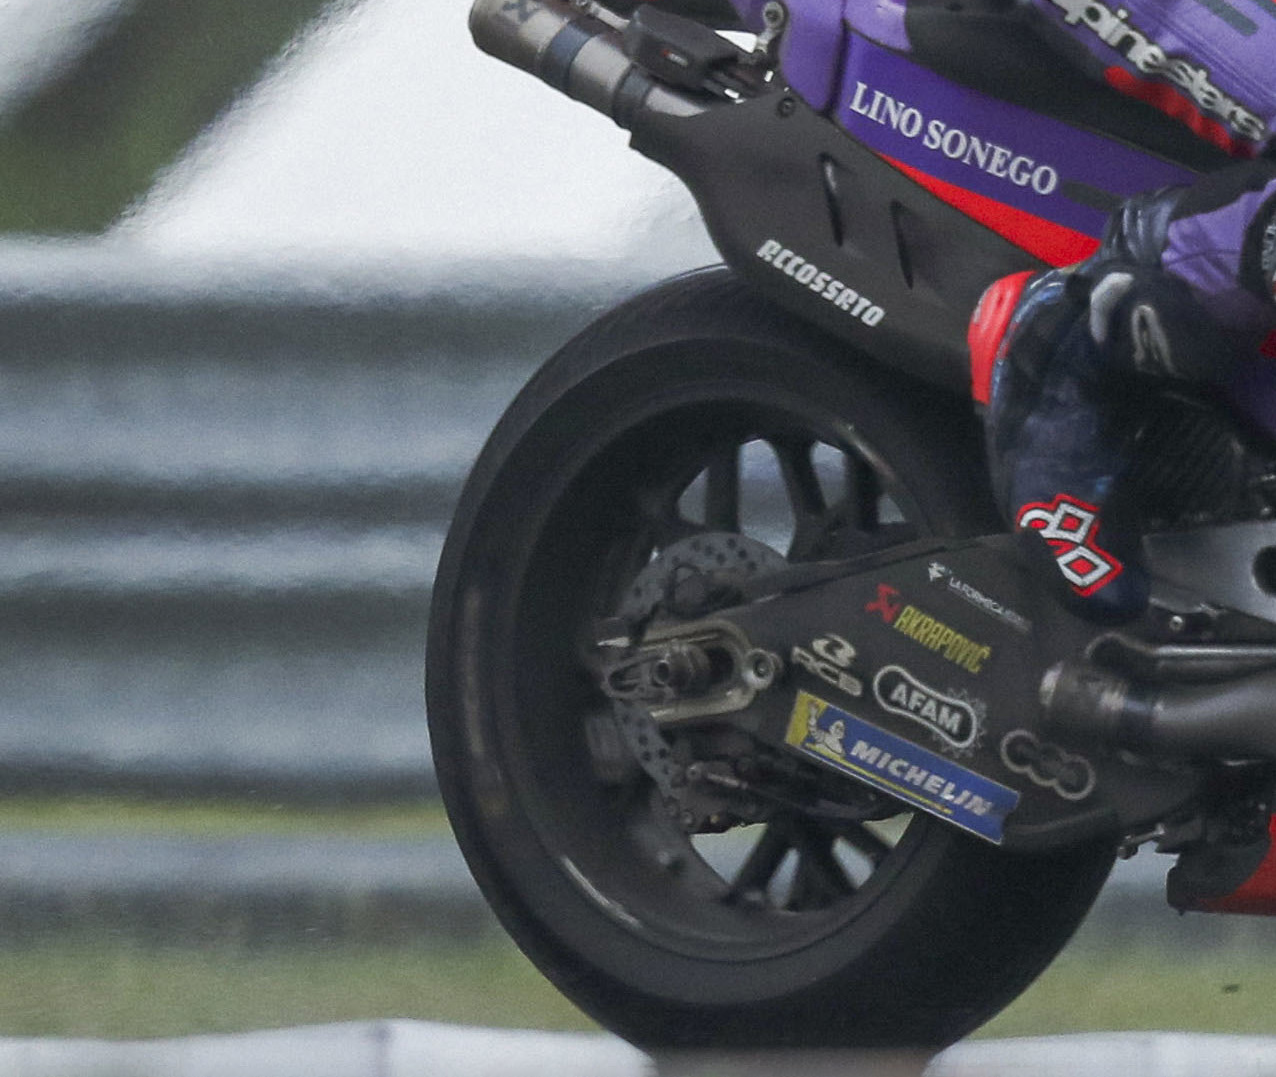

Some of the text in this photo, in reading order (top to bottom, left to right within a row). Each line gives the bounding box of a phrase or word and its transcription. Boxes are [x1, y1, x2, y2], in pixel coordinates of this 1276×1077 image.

[849, 82, 1058, 196] LINO SONEGO
[890, 681, 963, 735] AFAM
[850, 739, 994, 818] MICHELIN
